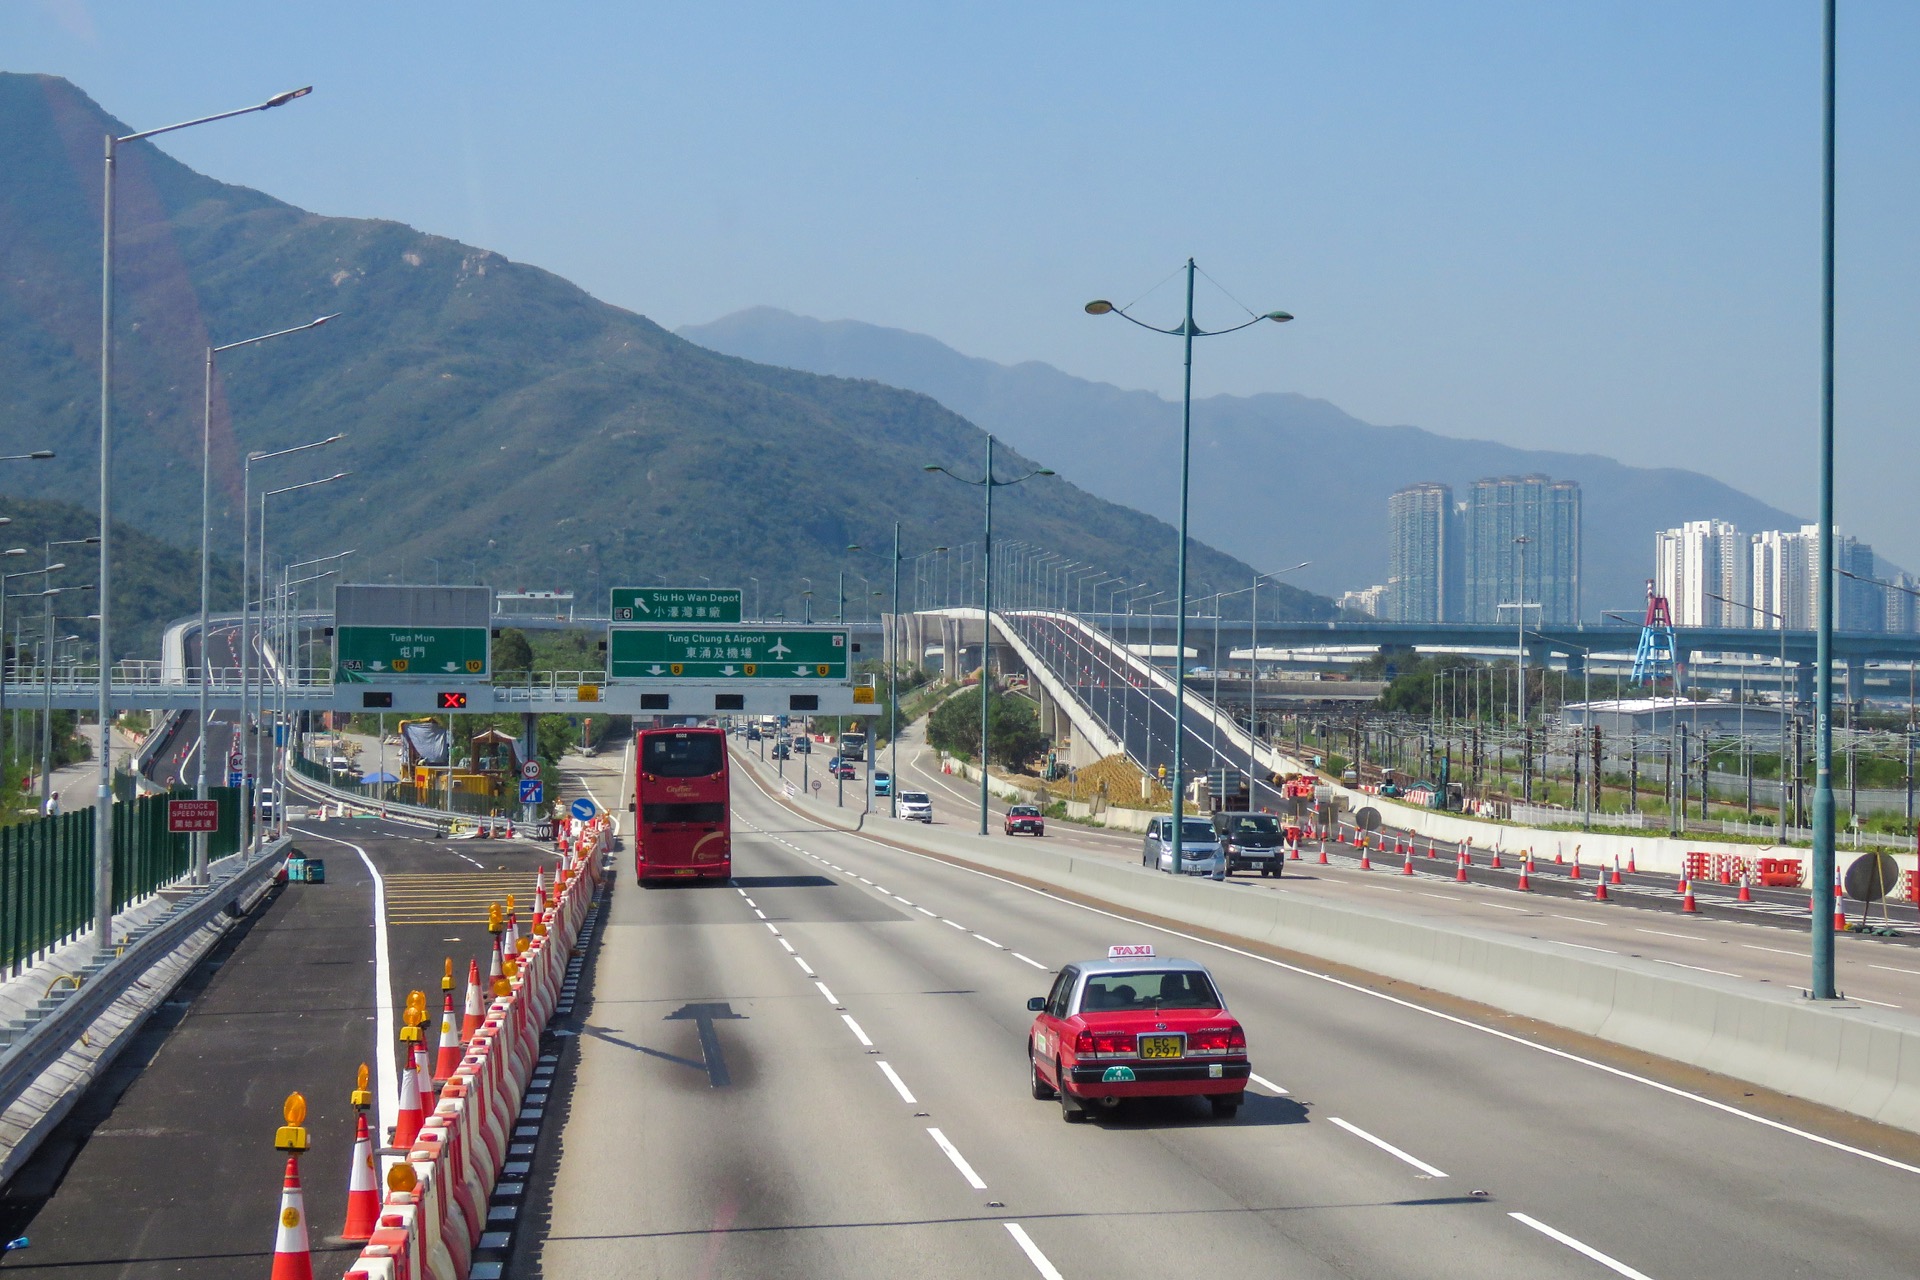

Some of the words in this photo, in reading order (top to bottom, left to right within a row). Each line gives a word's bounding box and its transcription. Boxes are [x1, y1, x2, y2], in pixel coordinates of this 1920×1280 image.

[653, 593, 668, 602] Siu
[671, 593, 684, 602] Ho
[687, 593, 708, 602] Wan
[710, 593, 739, 603] Depot
[623, 609, 631, 619] 6
[390, 633, 412, 642] Tuen
[414, 633, 435, 642] Mun
[668, 634, 690, 644] Tung
[692, 634, 722, 644] Chung
[724, 634, 731, 643] &
[733, 634, 766, 644] Airport
[399, 645, 425, 658] 屯門
[685, 646, 753, 659] 東涌及機場
[394, 661, 406, 669] 10
[468, 661, 480, 670] 10
[673, 665, 680, 674] 8
[746, 665, 753, 674] 8
[819, 665, 826, 674] 8
[525, 765, 538, 773] 80
[178, 802, 209, 810] REDUCE
[1113, 946, 1151, 955] TAXI
[1153, 1038, 1169, 1047] EC
[1146, 1046, 1177, 1058] 9297
[1115, 1069, 1122, 1077] 4
